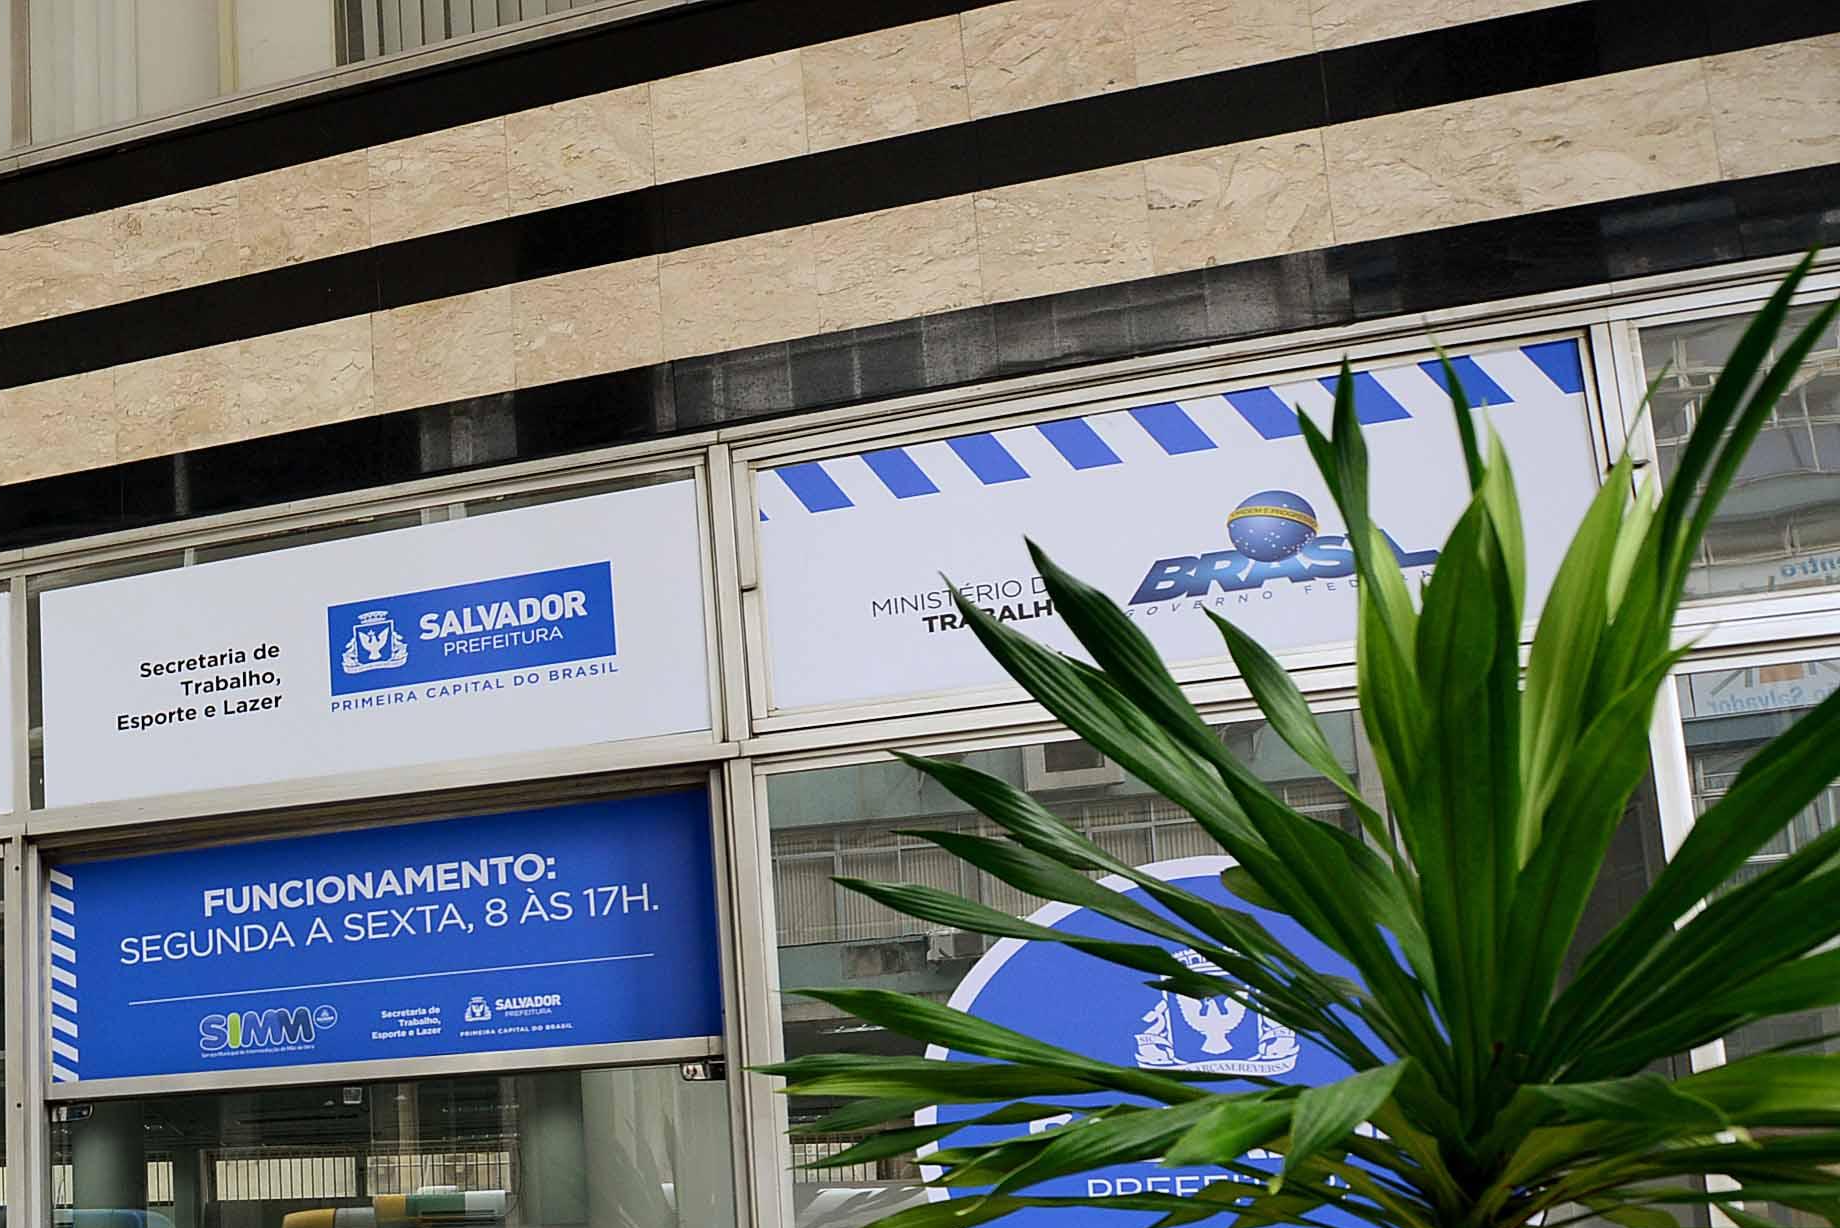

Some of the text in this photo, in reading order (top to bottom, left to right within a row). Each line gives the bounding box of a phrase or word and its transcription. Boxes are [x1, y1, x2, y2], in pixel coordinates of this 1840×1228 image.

[419, 590, 588, 641] SALVADOR
[872, 580, 1022, 618] MINISTÉRIO
[444, 626, 563, 656] PREFEITURA
[140, 643, 280, 678] Secretaria de
[180, 671, 281, 696] Trabalho,
[331, 662, 619, 713] PRIMEIRA CAPITAL DO BRASIL
[117, 694, 283, 731] Esporte e Lazer
[203, 853, 557, 917] FUNCIONAMENTO:
[120, 882, 659, 965] SEGUNDA A SEXTA, 8 ÀS 17H.
[381, 1006, 440, 1019] Secretaria de
[495, 994, 561, 1011] SALVADOR
[200, 1006, 316, 1051] SIMM
[371, 1030, 406, 1041] Esporte
[416, 1026, 441, 1036] Lazer
[399, 1017, 441, 1028] Trabalho,
[460, 1023, 574, 1038] PRIMEIRA CAPITAL DO BRASIL
